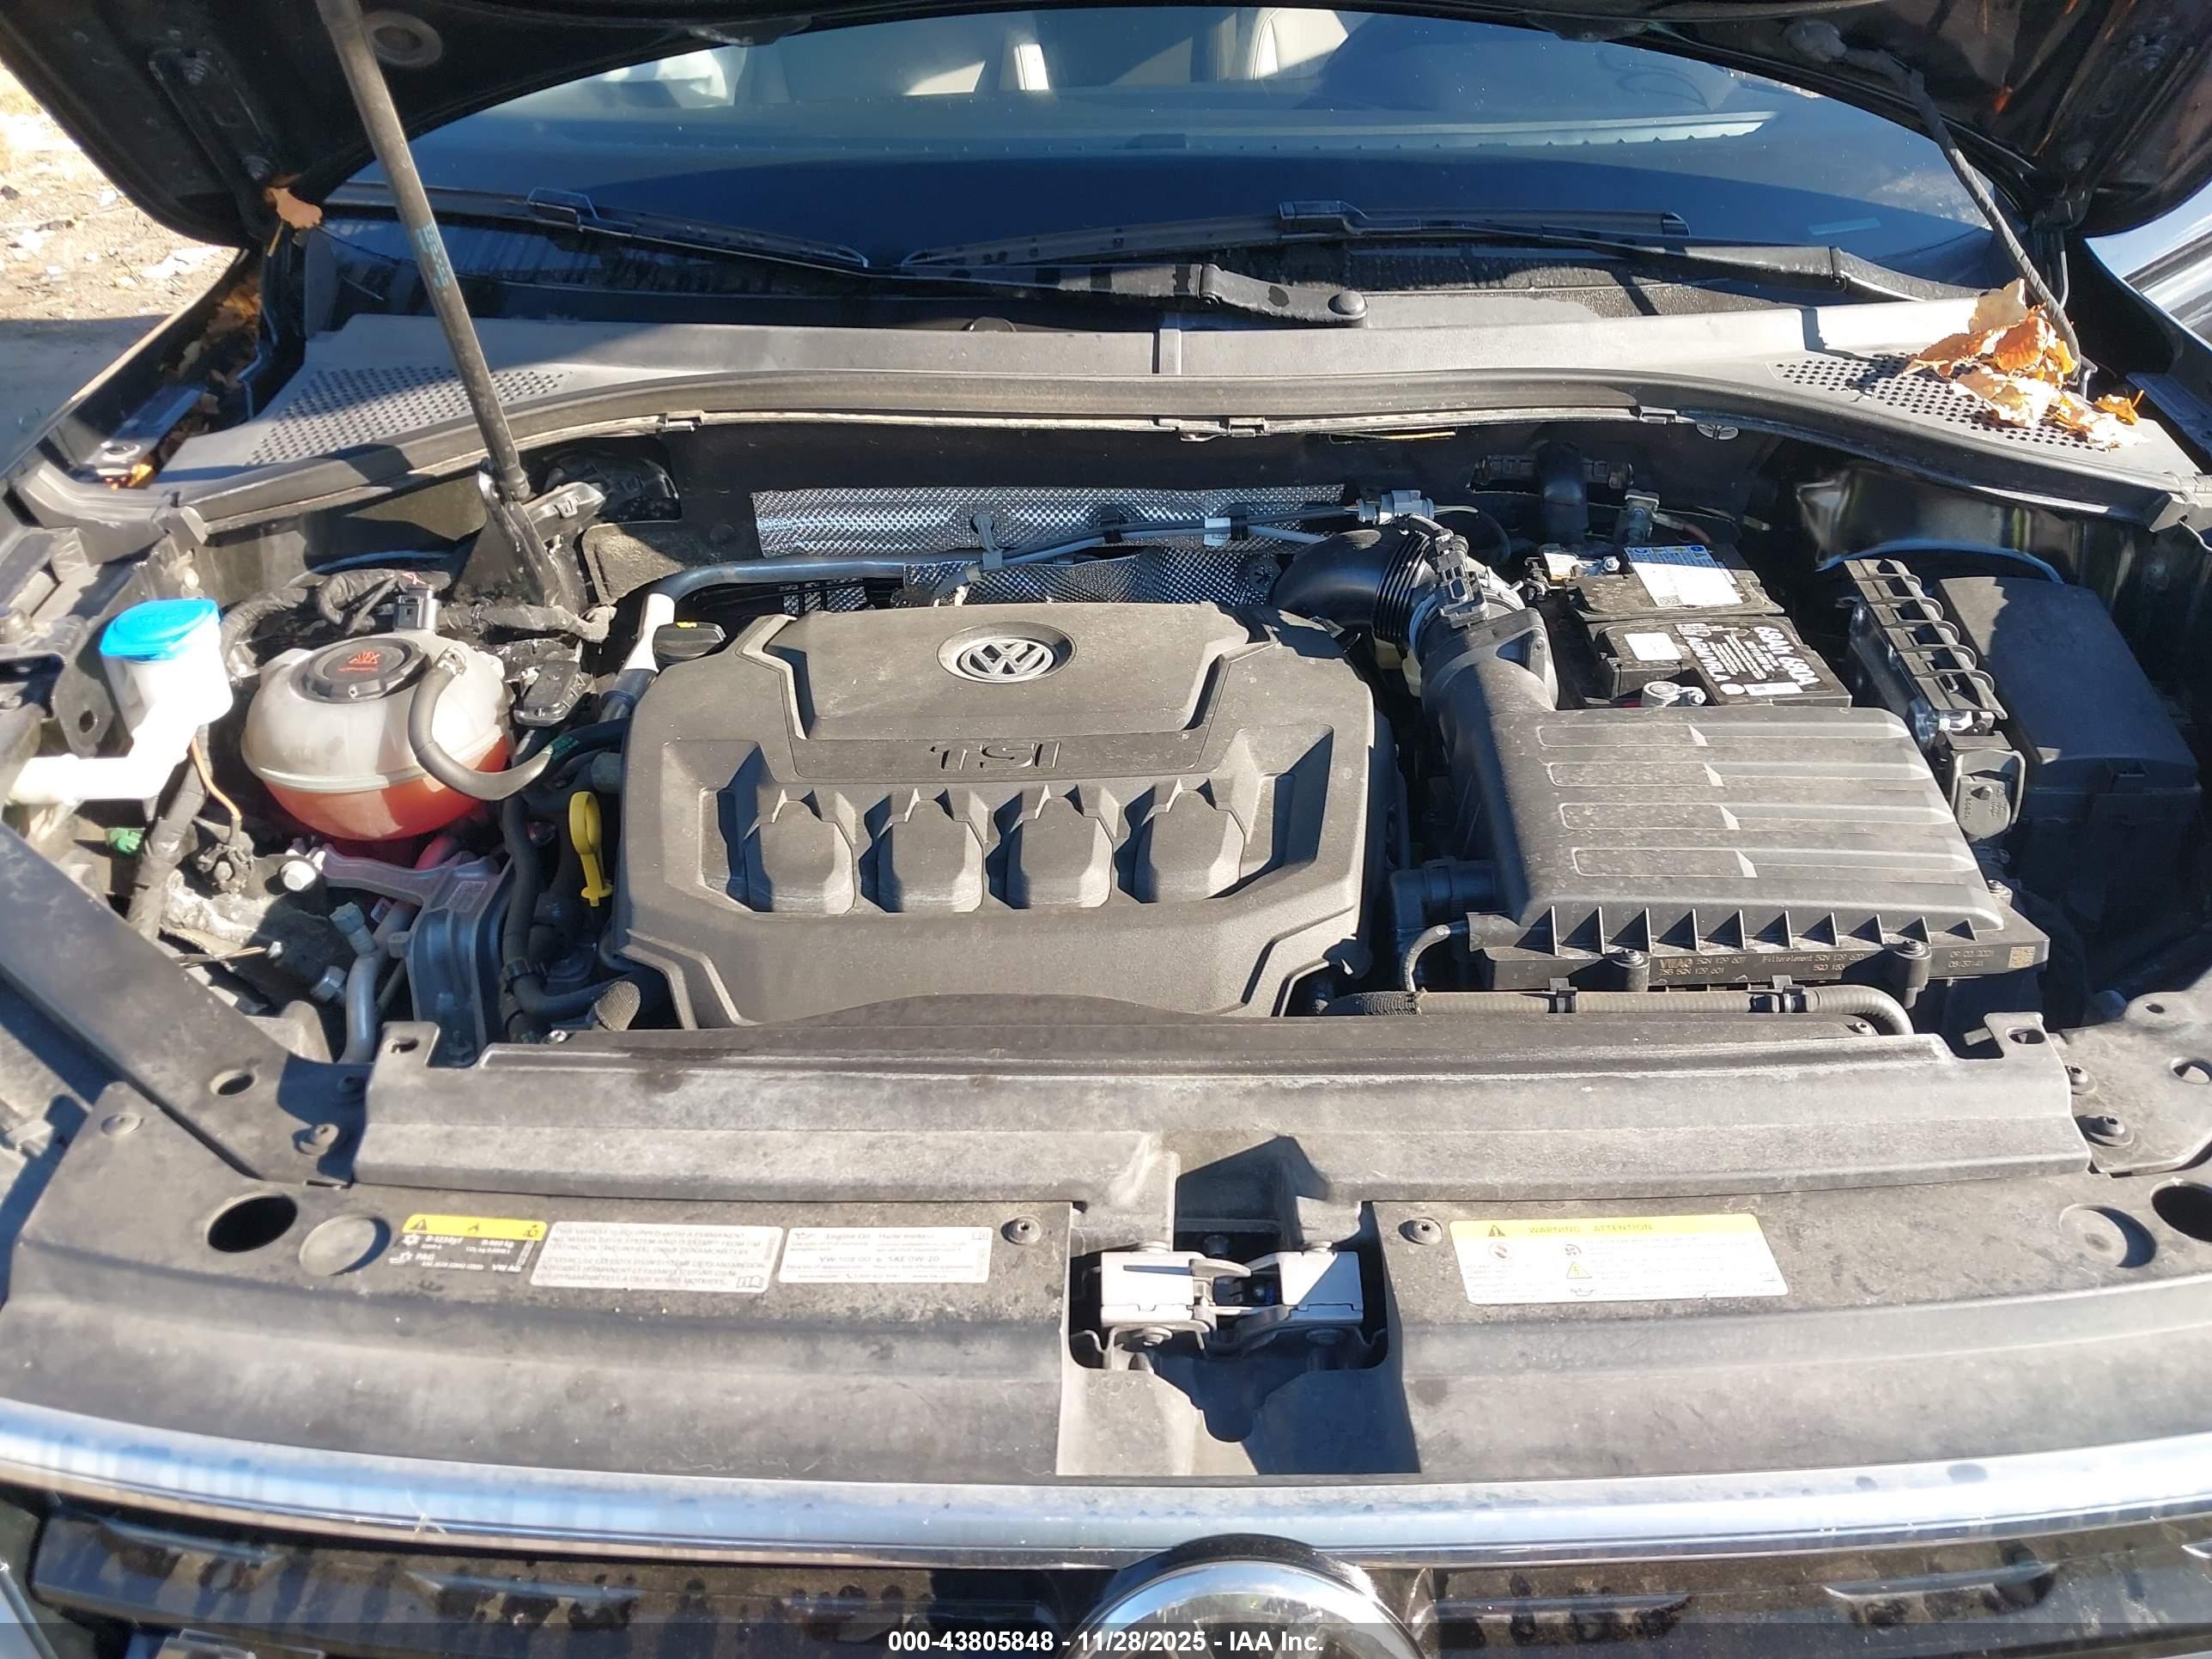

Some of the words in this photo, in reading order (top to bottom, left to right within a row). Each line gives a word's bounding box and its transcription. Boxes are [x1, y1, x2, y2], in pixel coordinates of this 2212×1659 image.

[1754, 627, 1794, 654] 68Ah
[1778, 657, 1820, 686] 680A
[930, 741, 1061, 770] TSI
[1594, 1224, 1653, 1232] ATTENTION
